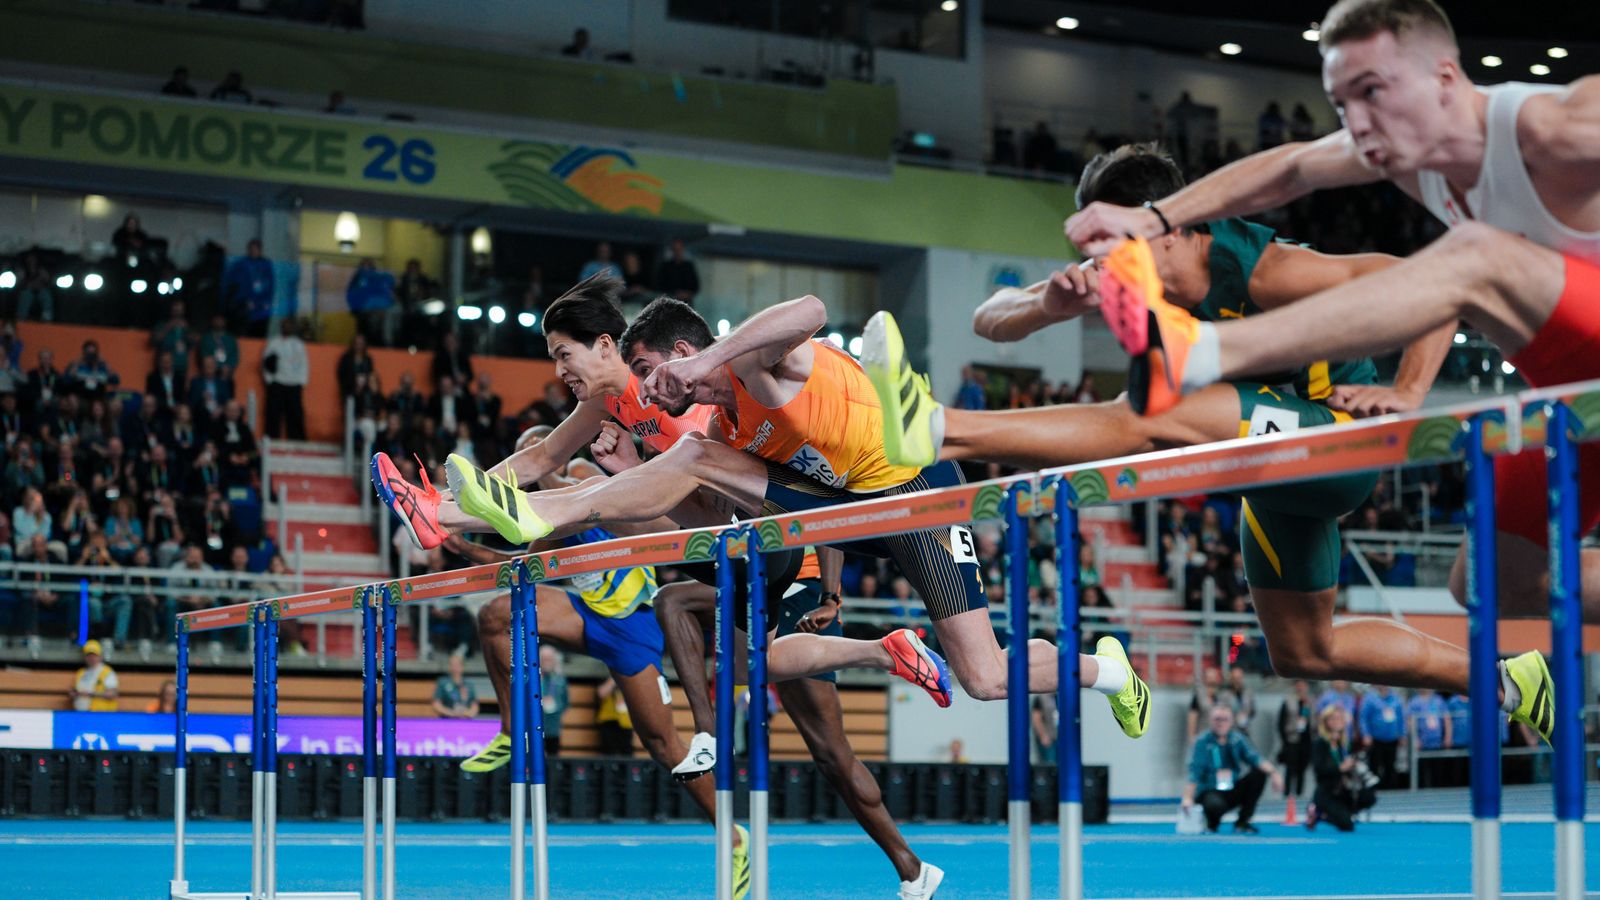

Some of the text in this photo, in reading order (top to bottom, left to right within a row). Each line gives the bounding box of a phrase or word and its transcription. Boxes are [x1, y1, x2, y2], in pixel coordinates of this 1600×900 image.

[53, 102, 347, 176] POMORZE
[363, 135, 436, 185] 26
[629, 417, 661, 438] APAN
[744, 419, 775, 454] SPAÑA
[959, 531, 974, 557] 5
